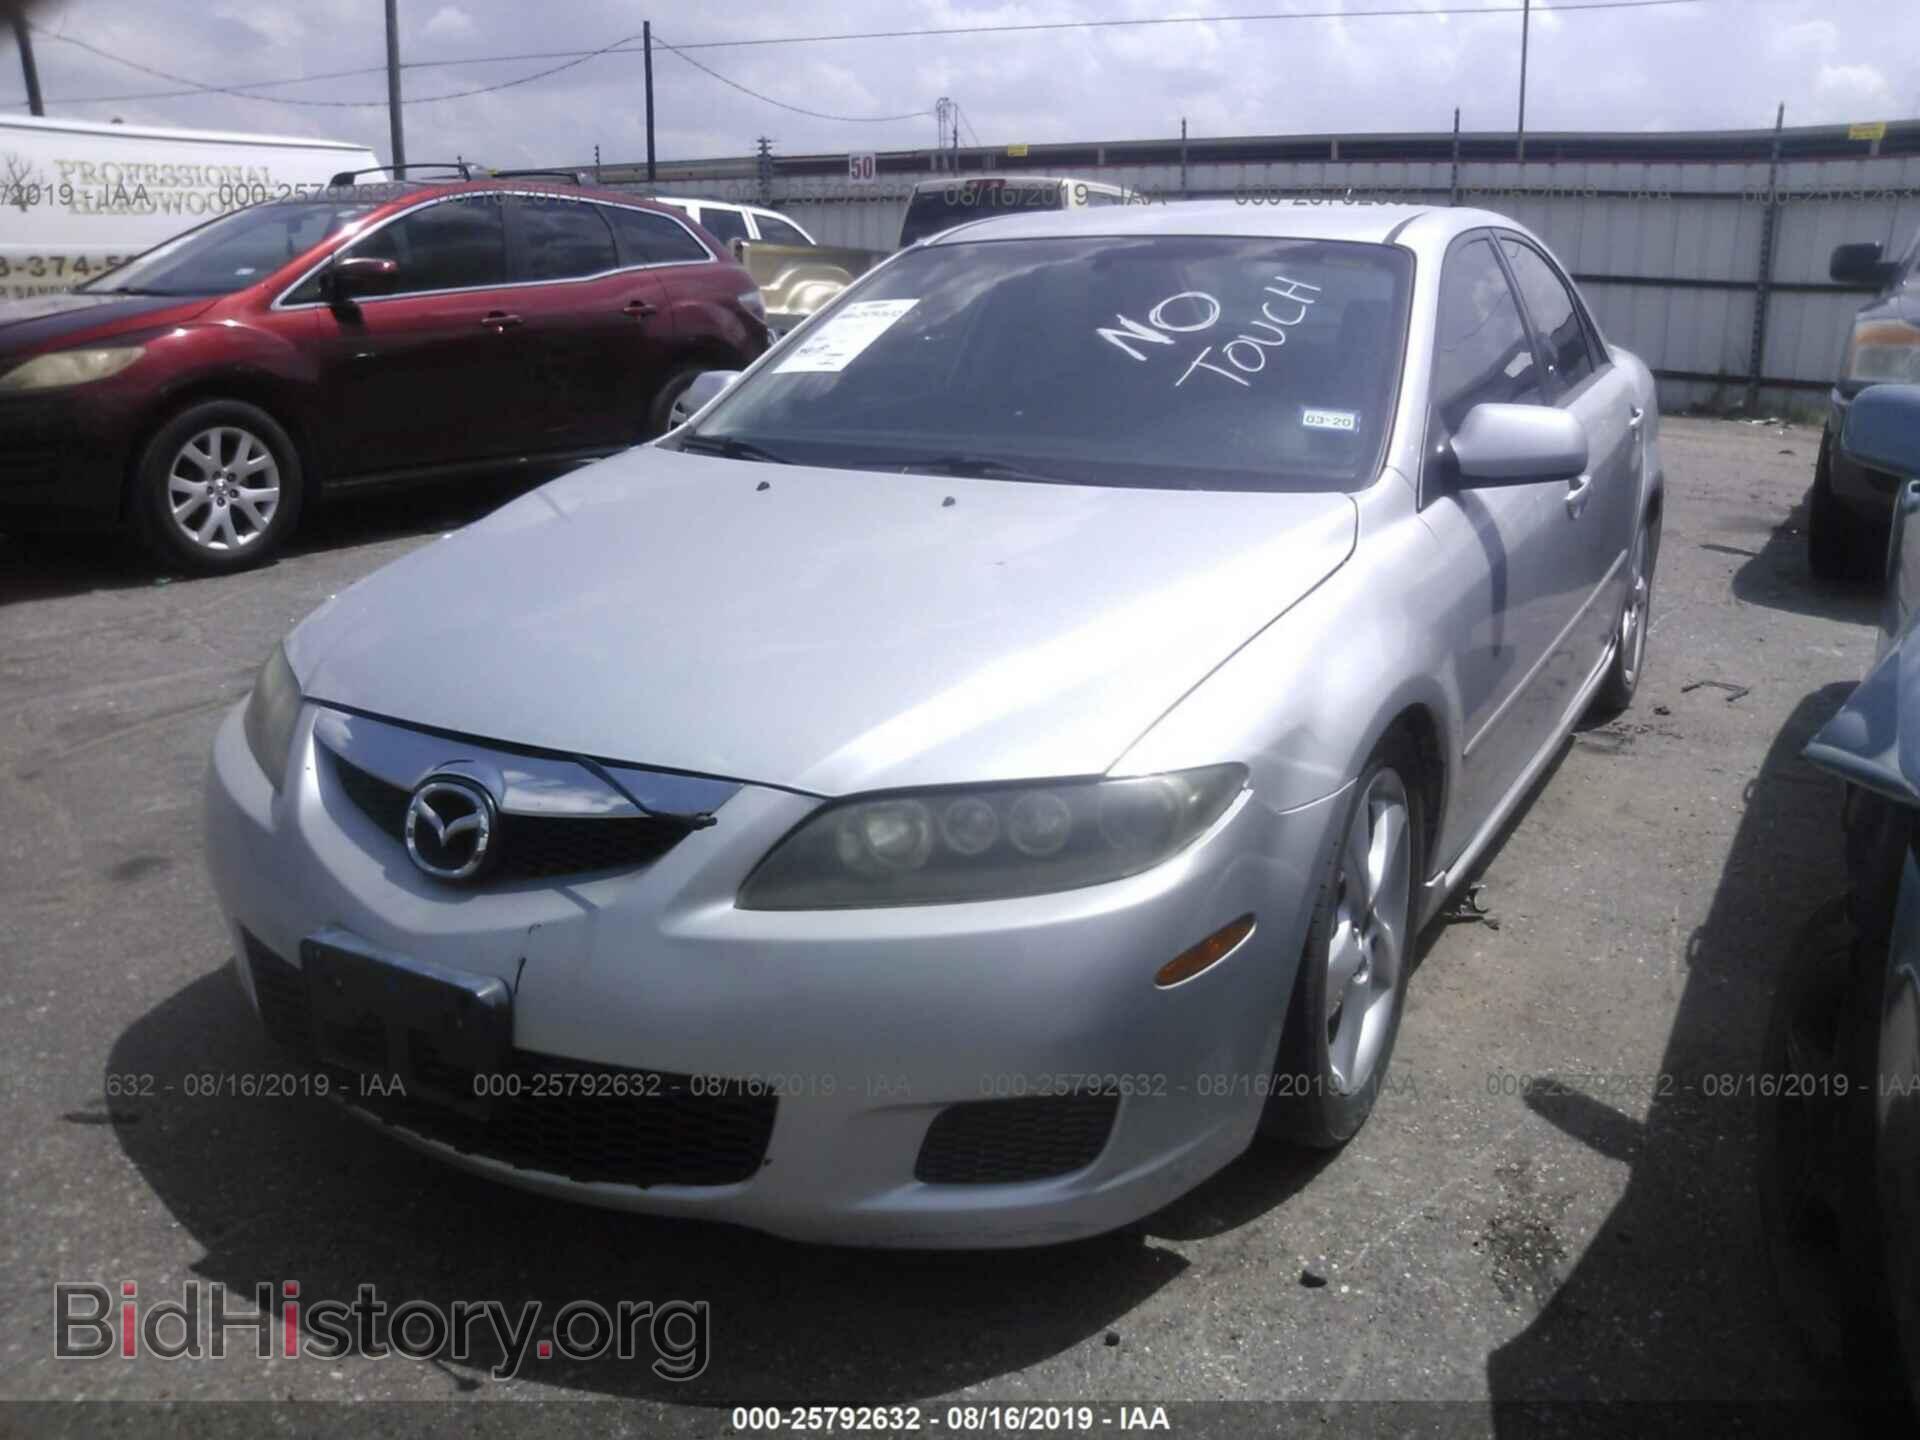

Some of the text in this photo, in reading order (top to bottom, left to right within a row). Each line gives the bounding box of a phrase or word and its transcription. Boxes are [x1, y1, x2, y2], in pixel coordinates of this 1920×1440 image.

[53, 160, 278, 188] PROFESSIONAL
[851, 156, 873, 180] 50
[1096, 290, 1221, 363] NO
[1175, 276, 1322, 387] TOUCH
[1306, 415, 1351, 427] 03-20
